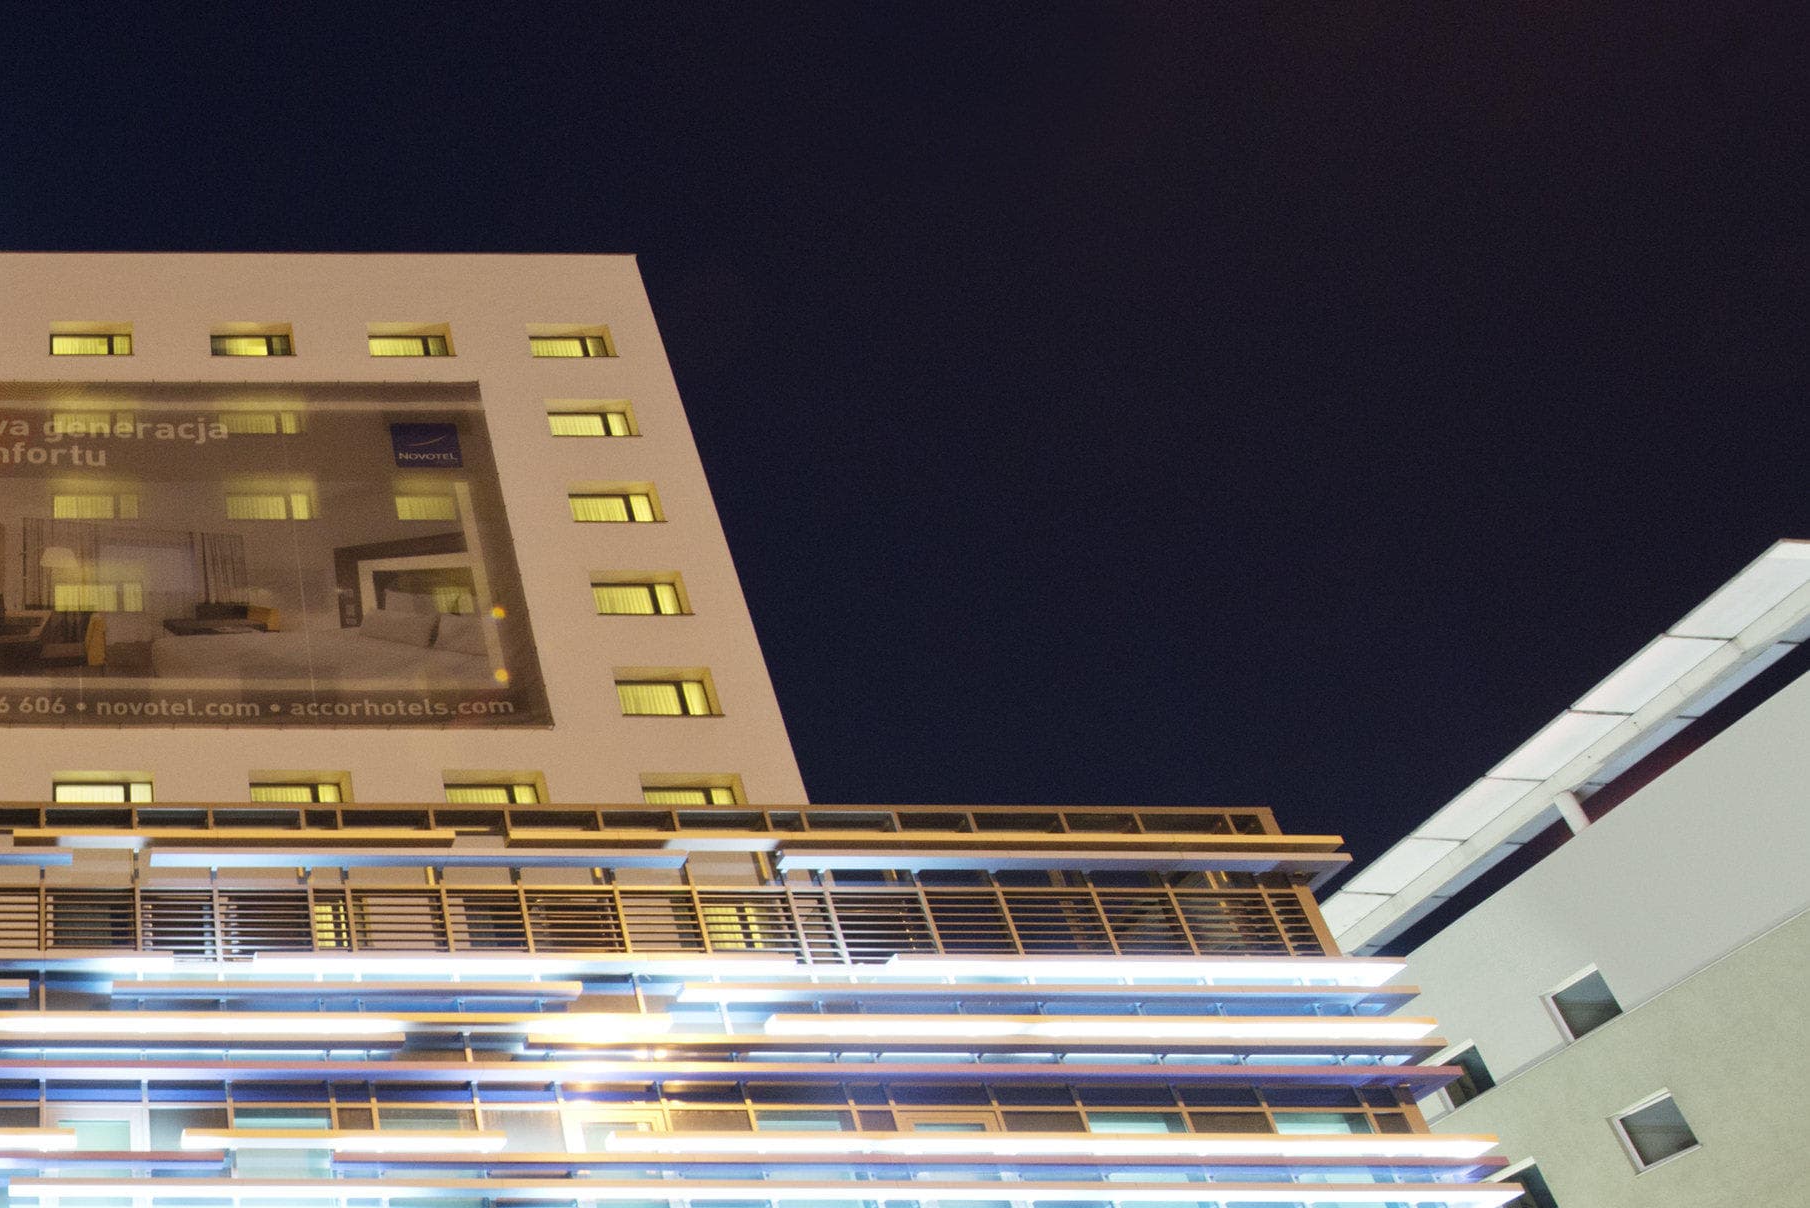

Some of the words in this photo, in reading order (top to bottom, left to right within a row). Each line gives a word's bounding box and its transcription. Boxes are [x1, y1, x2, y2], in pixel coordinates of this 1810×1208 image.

[43, 416, 230, 444] generacja
[398, 452, 458, 461] NOVOTEL
[18, 696, 67, 714] 606
[96, 698, 261, 716] novotel.com
[290, 698, 515, 716] accorhotels.com
